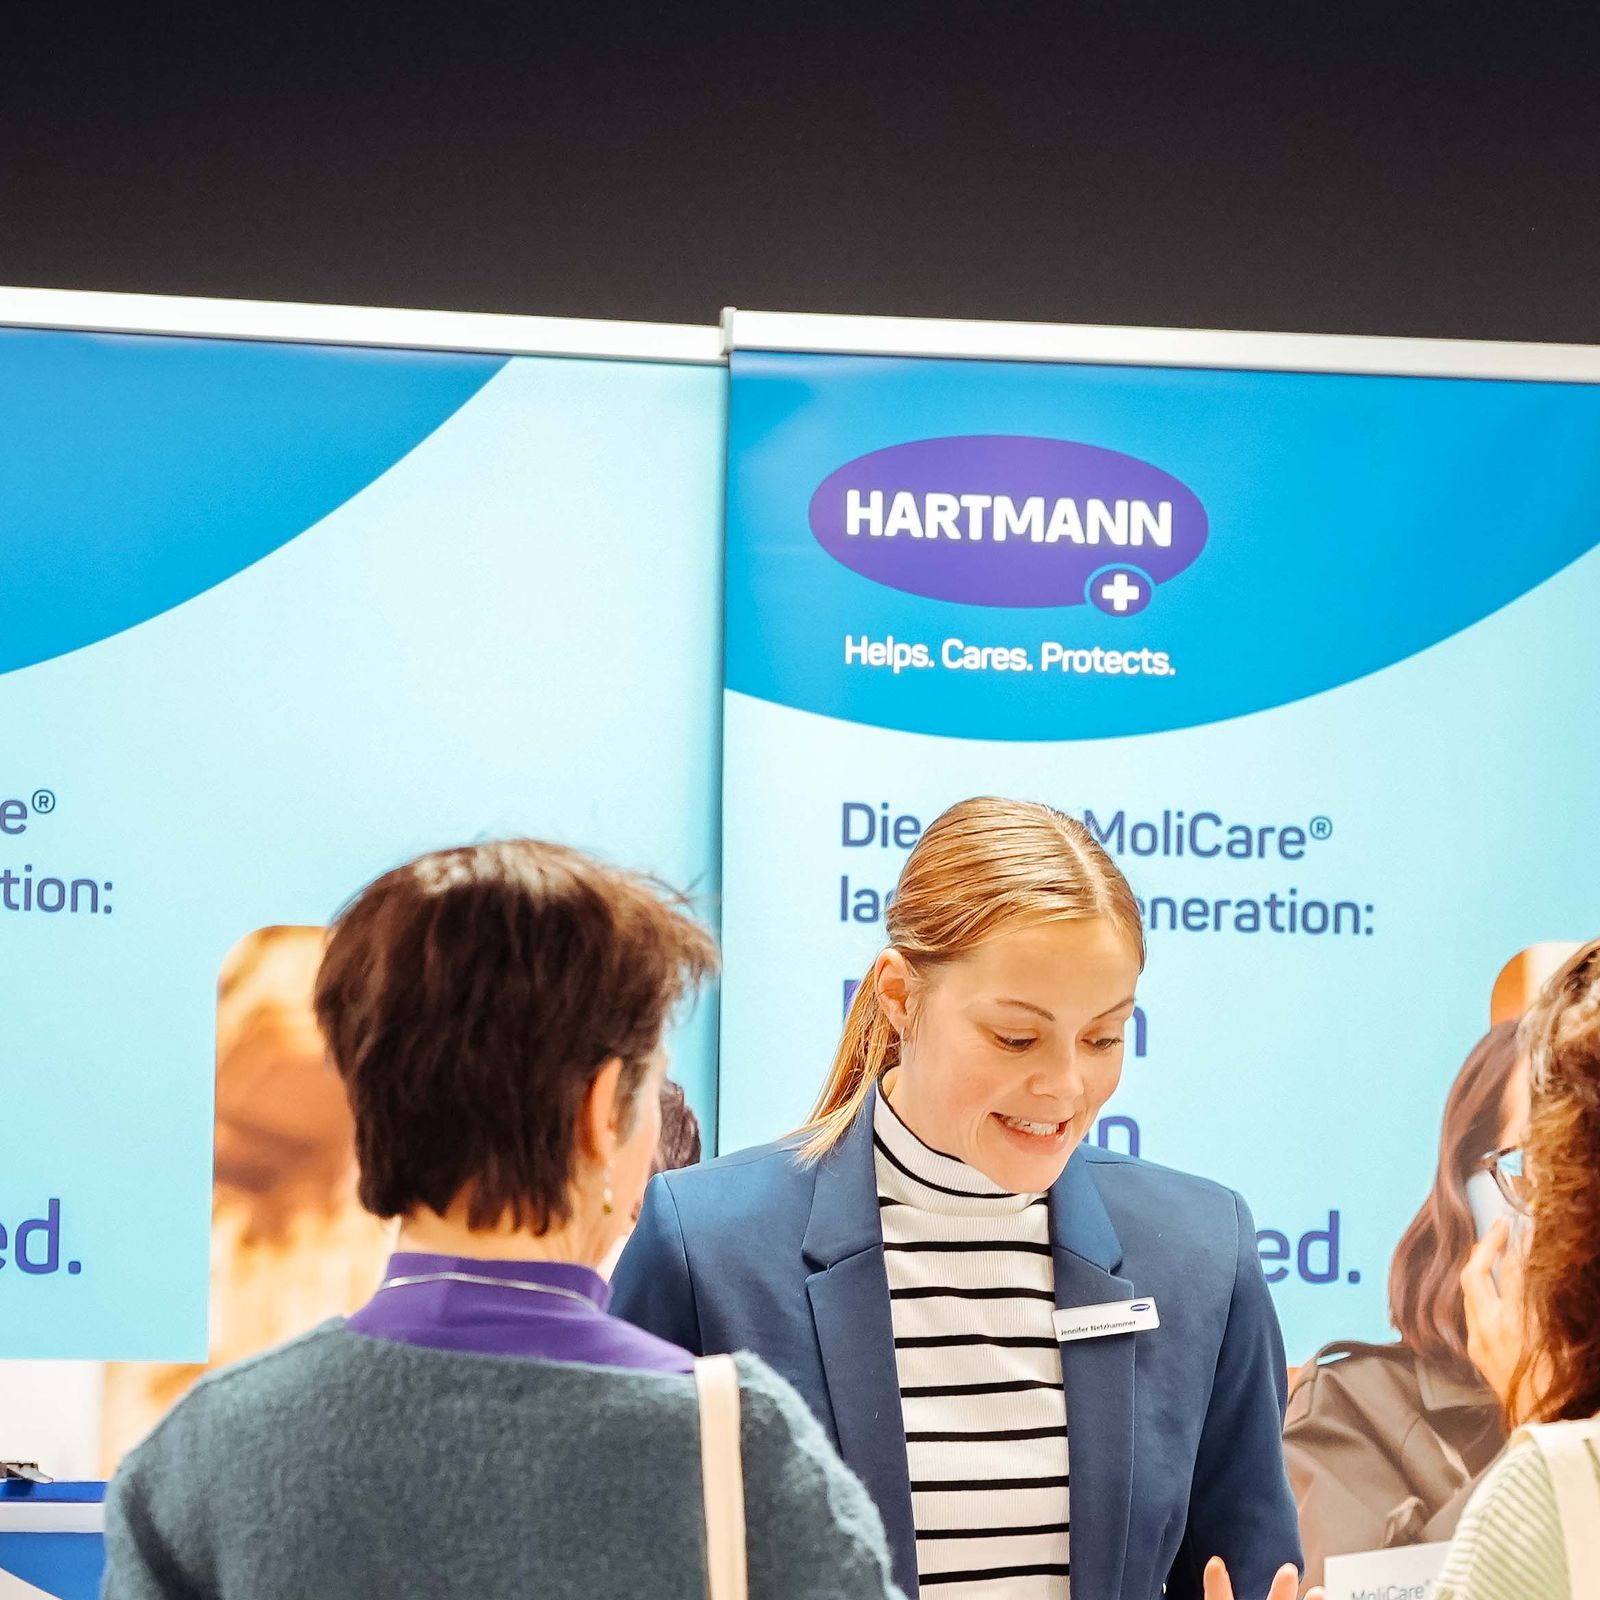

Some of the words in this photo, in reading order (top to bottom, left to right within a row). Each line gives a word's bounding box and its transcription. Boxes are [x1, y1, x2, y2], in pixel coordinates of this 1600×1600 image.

[845, 488, 1173, 547] HARTMANN
[844, 633, 935, 675] Helps.
[941, 637, 1034, 673] Cares.
[1040, 641, 1177, 677] Protects.
[842, 801, 921, 850] Die
